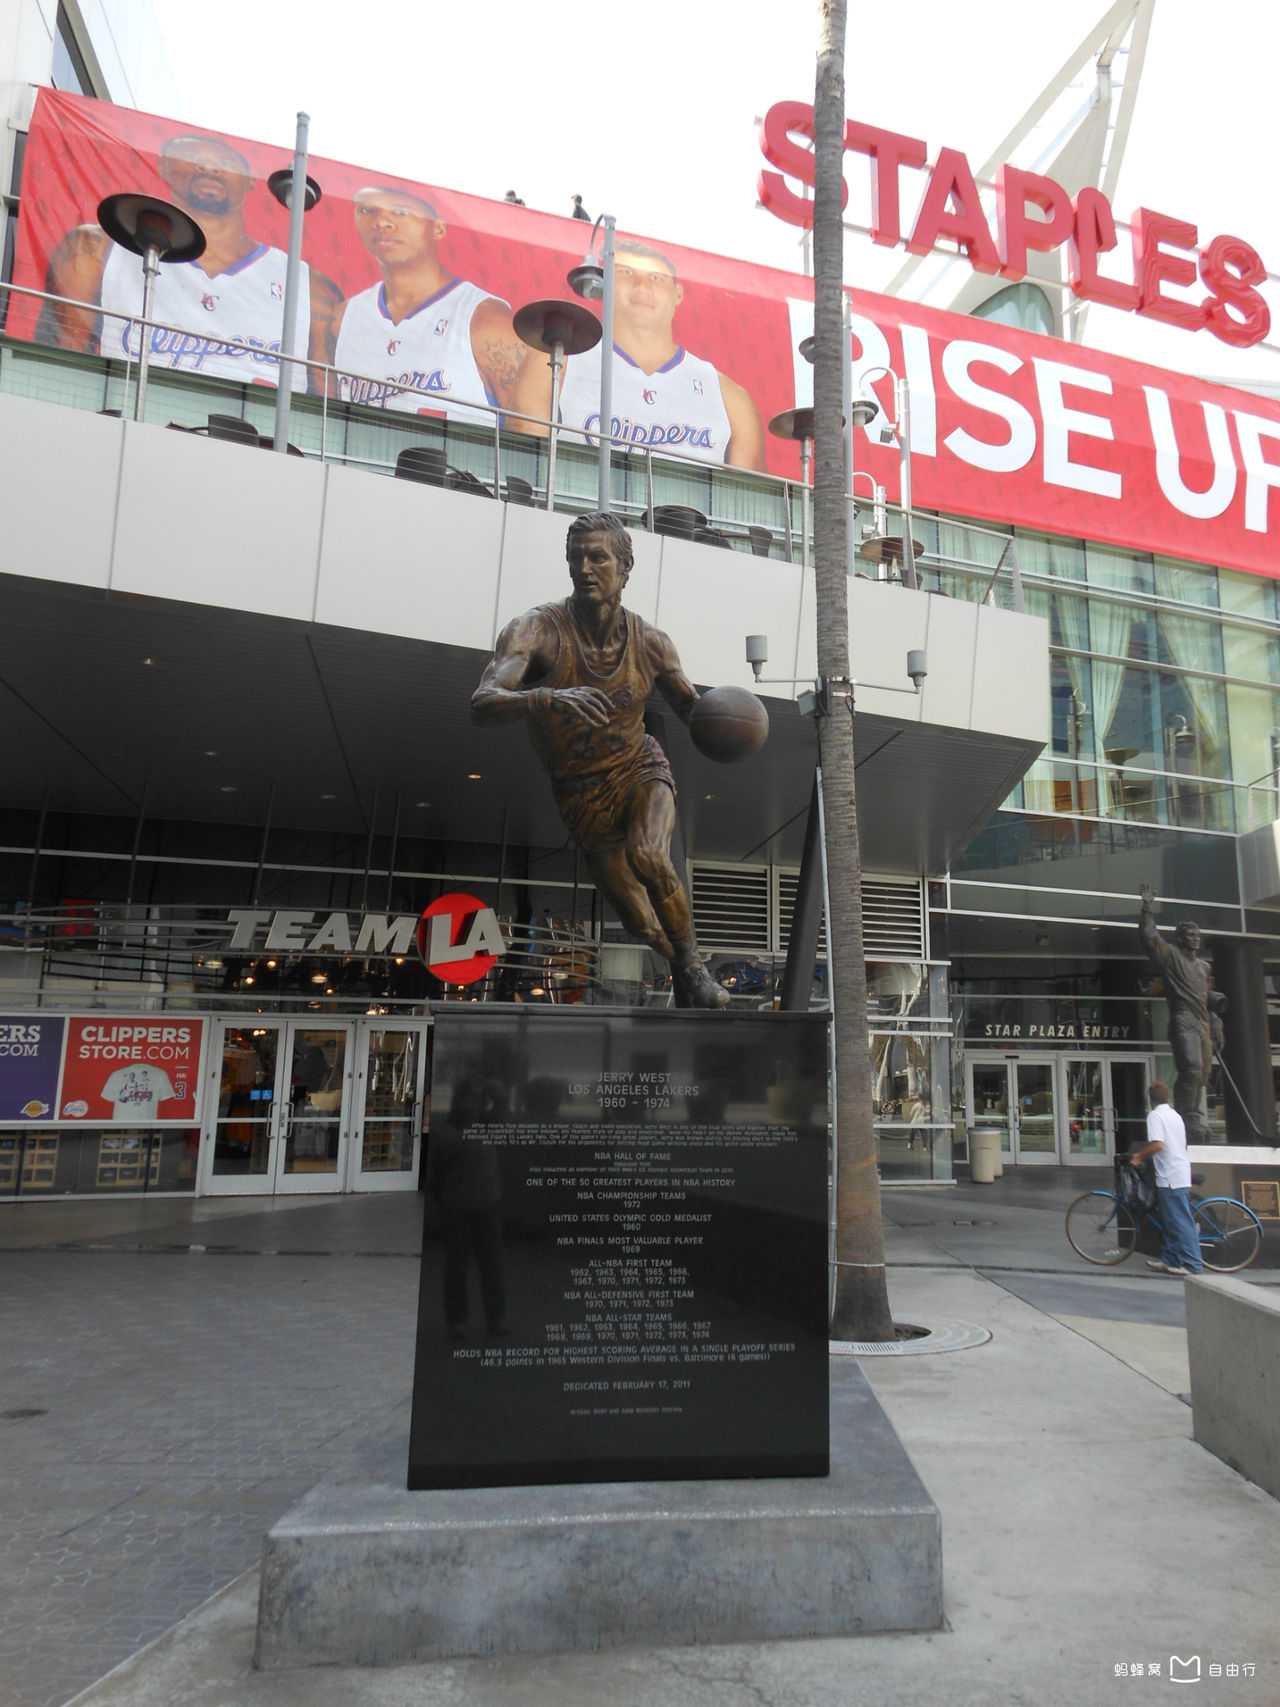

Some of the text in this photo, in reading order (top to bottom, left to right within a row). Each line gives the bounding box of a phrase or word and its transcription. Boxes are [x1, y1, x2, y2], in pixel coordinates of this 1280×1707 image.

[756, 100, 1272, 349] STAPLES
[787, 297, 1123, 500] RISE
[584, 412, 716, 456] Clippers
[227, 906, 507, 967] TEAM LA
[80, 1025, 191, 1044] CLIPPERS
[985, 1023, 1130, 1040] STAR PLAZA ENTRY
[79, 1045, 190, 1060] STORE.COM
[598, 1072, 672, 1083] JERRY WEST
[568, 1084, 699, 1096] LOS ANGELES LAKERS
[597, 1098, 626, 1108] 1960
[643, 1098, 670, 1108] 1974
[594, 1152, 670, 1161] NBA HALL OF FAME
[634, 1179, 668, 1187] PLAYERS
[671, 1179, 680, 1187] IN
[683, 1179, 699, 1187] NBA
[702, 1179, 734, 1187] HISTORY
[577, 1192, 685, 1200] NBA CHAMPIONSHIP TEAMS
[548, 1214, 712, 1222] UNITED STATES OLYMPIC GOLD MEDALIST
[622, 1223, 641, 1231] 1960
[556, 1237, 703, 1245] NBA FINALS MOST VALUABLE PLAYER
[588, 1259, 672, 1267] ALL-NBA FIRST TEAM
[564, 1291, 581, 1299] NBA
[583, 1291, 643, 1299] ALL-DEFENSIVE
[673, 1290, 694, 1298] TEAM
[585, 1313, 672, 1322] NBA ALL-STAR TEAMS
[453, 1350, 482, 1358] HOLDS
[484, 1349, 502, 1357] NBA
[505, 1348, 540, 1357] RECORD
[543, 1348, 559, 1356] FOR
[563, 1347, 598, 1356] HIGHEST
[601, 1346, 637, 1355] SCORING
[640, 1346, 675, 1354] AVERAGE
[692, 1345, 698, 1353] A
[701, 1345, 728, 1353] SINGLE
[731, 1344, 764, 1352] PLAYOFF
[768, 1343, 795, 1352] SERIES
[563, 1380, 690, 1391] DEDICATED FEBRUARY 17, 2011
